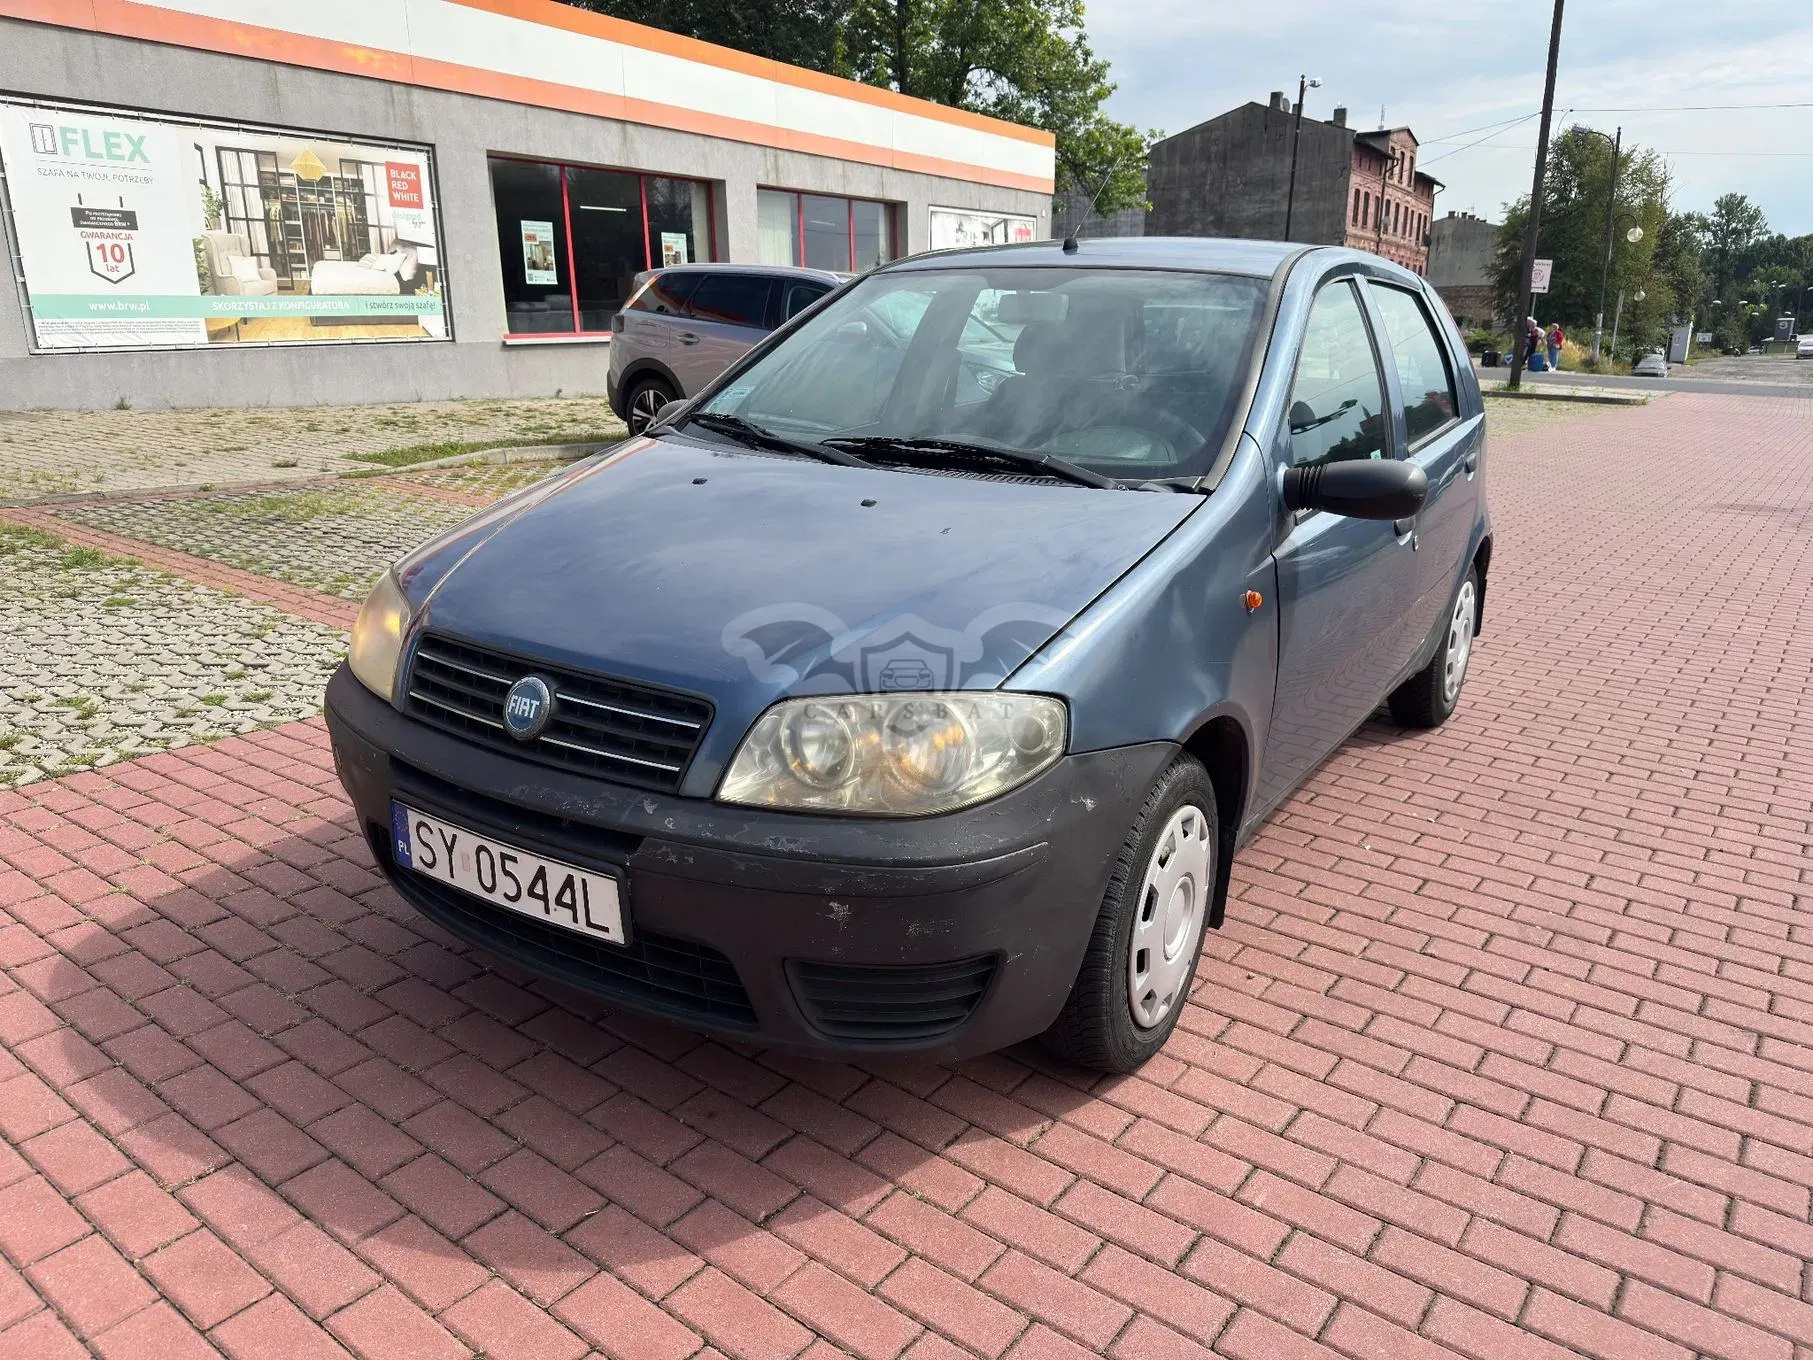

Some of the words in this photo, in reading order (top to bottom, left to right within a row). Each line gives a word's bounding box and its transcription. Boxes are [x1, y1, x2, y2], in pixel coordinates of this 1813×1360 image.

[59, 126, 151, 164] FLEX
[37, 167, 66, 178] SZAFA
[66, 170, 80, 178] NA
[112, 174, 154, 185] POTRZEBY
[390, 169, 417, 180] BLACK
[391, 180, 409, 191] RED
[392, 191, 420, 203] WHITE
[80, 230, 134, 241] GWARANCJA
[96, 243, 125, 264] 10
[106, 263, 120, 273] lat
[88, 301, 151, 313] www.brw.pl
[212, 301, 270, 311] SKORZYSTAJ
[279, 301, 350, 310] KONFIGURATORA
[395, 301, 415, 311] swoją
[507, 694, 541, 719] FIAT
[398, 839, 410, 856] PL
[415, 820, 458, 879] SY
[475, 844, 610, 934] 0544L
